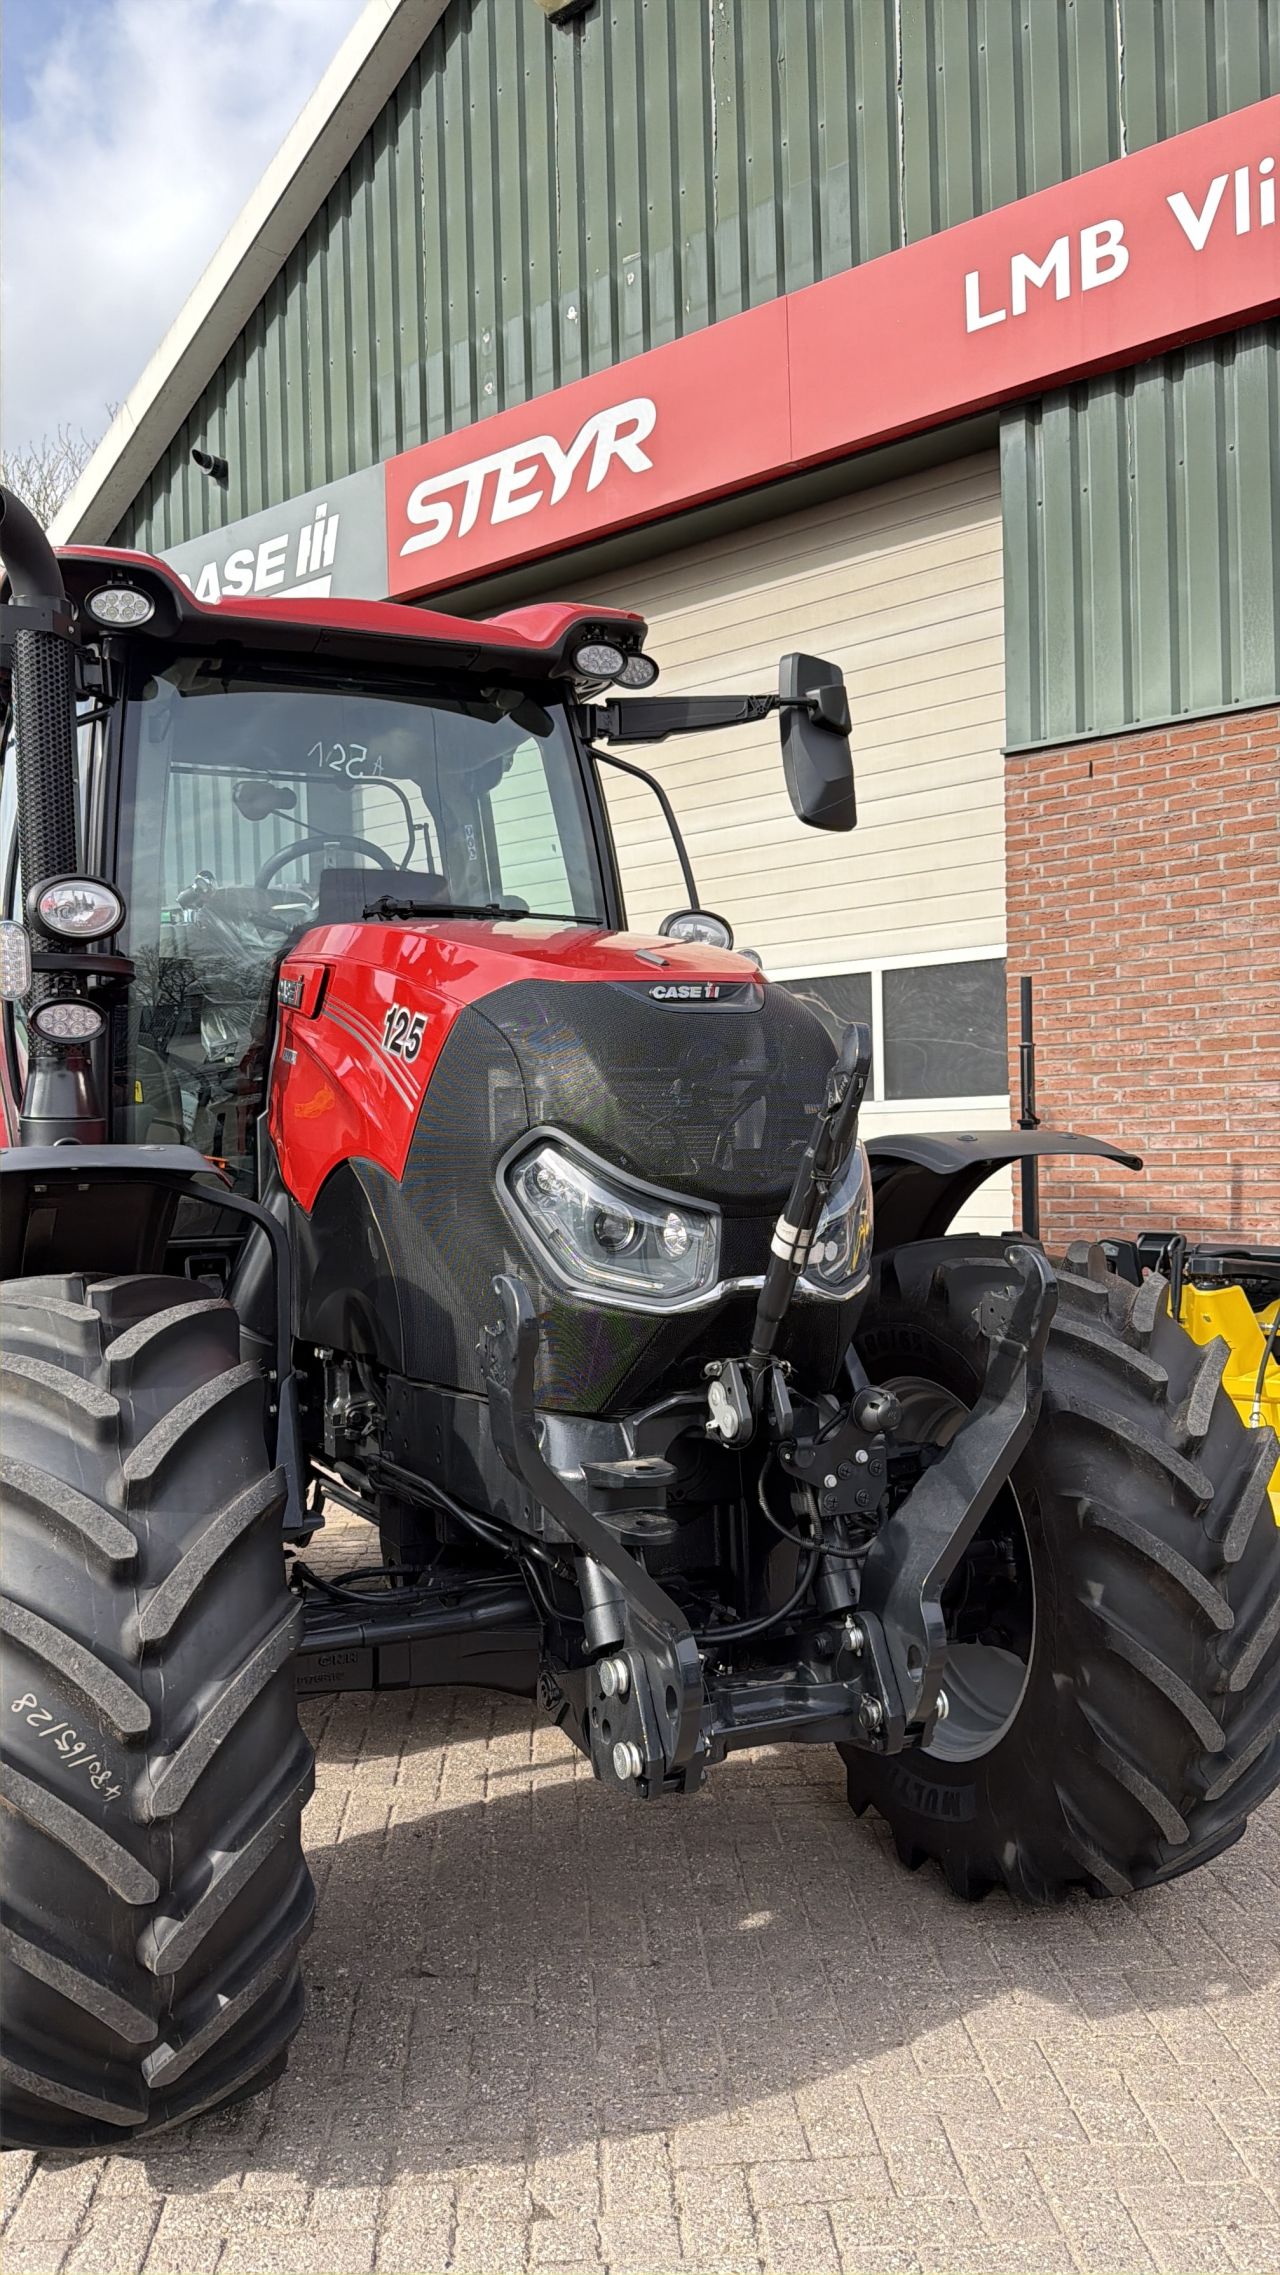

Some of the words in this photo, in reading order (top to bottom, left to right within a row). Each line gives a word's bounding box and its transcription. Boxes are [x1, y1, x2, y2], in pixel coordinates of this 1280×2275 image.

[965, 219, 1130, 333] LMB
[400, 398, 657, 557] STEYR
[381, 1002, 428, 1063] 125
[652, 985, 702, 999] CASE
